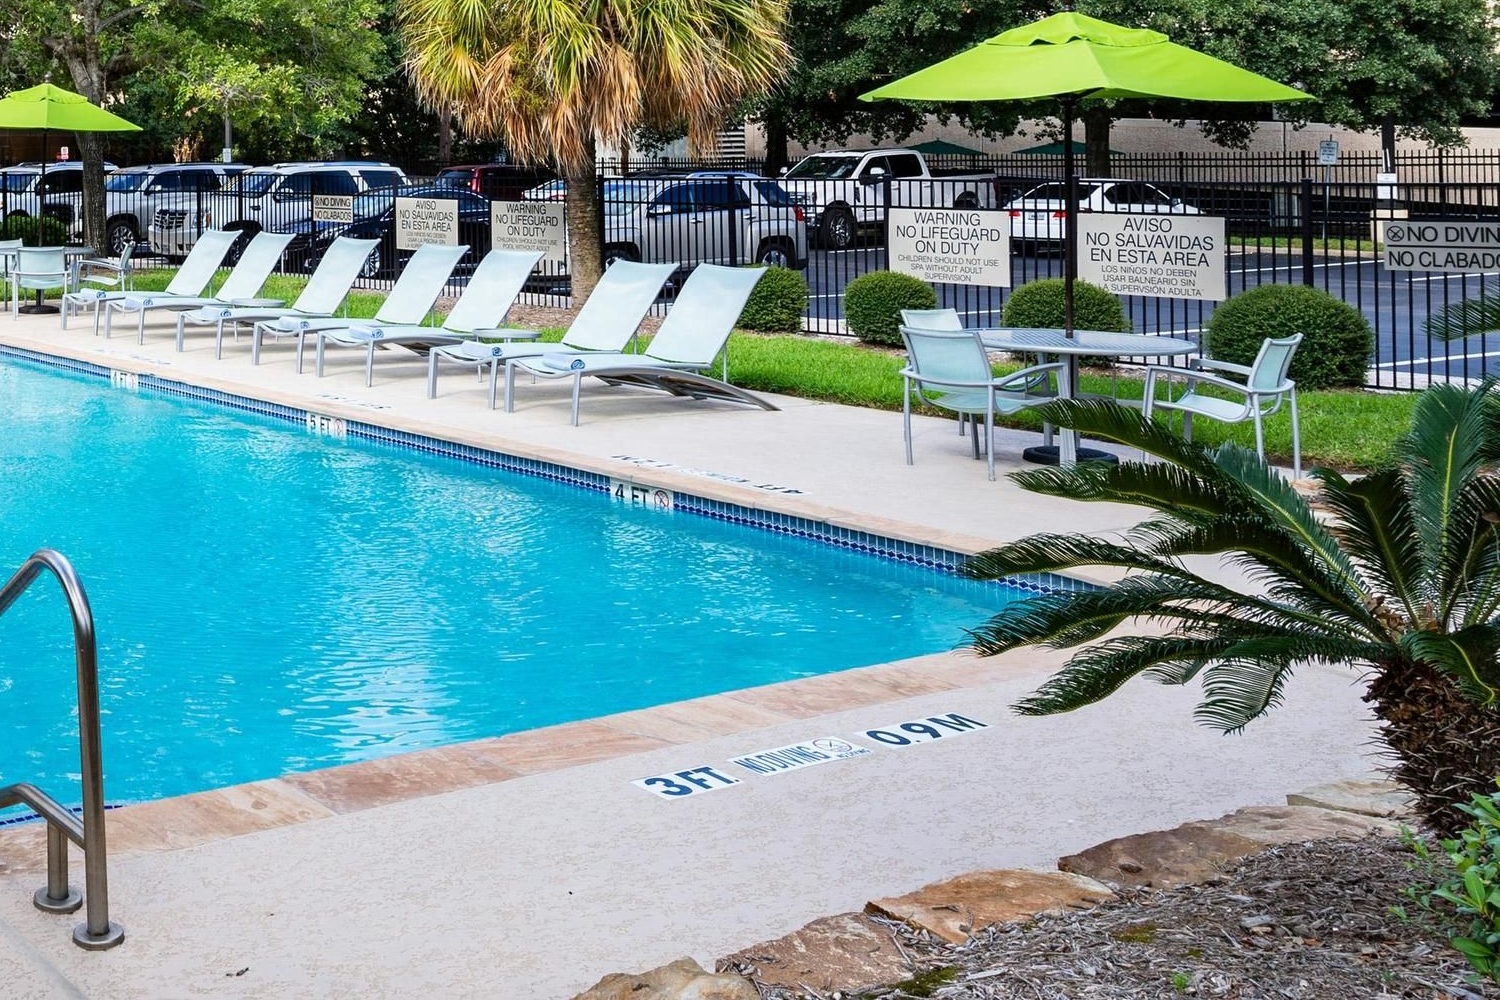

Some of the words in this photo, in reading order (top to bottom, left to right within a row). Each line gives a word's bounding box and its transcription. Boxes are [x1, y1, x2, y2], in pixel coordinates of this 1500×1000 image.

[320, 198, 329, 206] NO
[330, 198, 351, 207] DIVING
[416, 200, 436, 210] AVISO
[506, 204, 546, 214] WARNING
[400, 210, 410, 219] NO
[412, 210, 454, 222] SALVAVIDAS
[496, 214, 508, 224] NO
[511, 215, 558, 226] LIFEGUARD
[914, 212, 980, 226] WARNING
[402, 220, 411, 229] EN
[413, 221, 430, 230] ESTA
[432, 222, 452, 232] AREA
[1123, 218, 1172, 232] AVISO
[507, 226, 520, 236] ON
[522, 227, 546, 237] DUTY
[896, 225, 916, 238] NO
[921, 226, 1000, 241] LIFEGUARD
[1407, 226, 1438, 242] NO
[1444, 226, 1500, 243] DIVIN
[1086, 232, 1109, 246] NO
[1115, 233, 1214, 250] SALVAVIDAS
[915, 240, 936, 253] ON
[941, 242, 980, 255] DUTY
[898, 254, 932, 263] CHILDREN
[934, 256, 964, 265] SHOULD
[966, 258, 981, 266] NOT
[983, 259, 999, 267] USE
[1090, 248, 1111, 262] EN
[1118, 249, 1157, 264] ESTA
[1162, 252, 1210, 267] AREA
[1388, 250, 1414, 267] NO
[1419, 251, 1500, 269] CLABAD
[911, 263, 924, 271] SPA
[925, 264, 958, 272] WITHOUT
[960, 266, 982, 274] ADULT
[1101, 265, 1118, 273] LOS
[1150, 268, 1163, 276] NO
[1166, 269, 1196, 277] DEBEN
[924, 272, 972, 282] SUPERVISION
[1128, 276, 1178, 286] BALNEARIO
[1181, 278, 1195, 287] SIN
[615, 484, 624, 498] 4
[631, 486, 649, 503] FT
